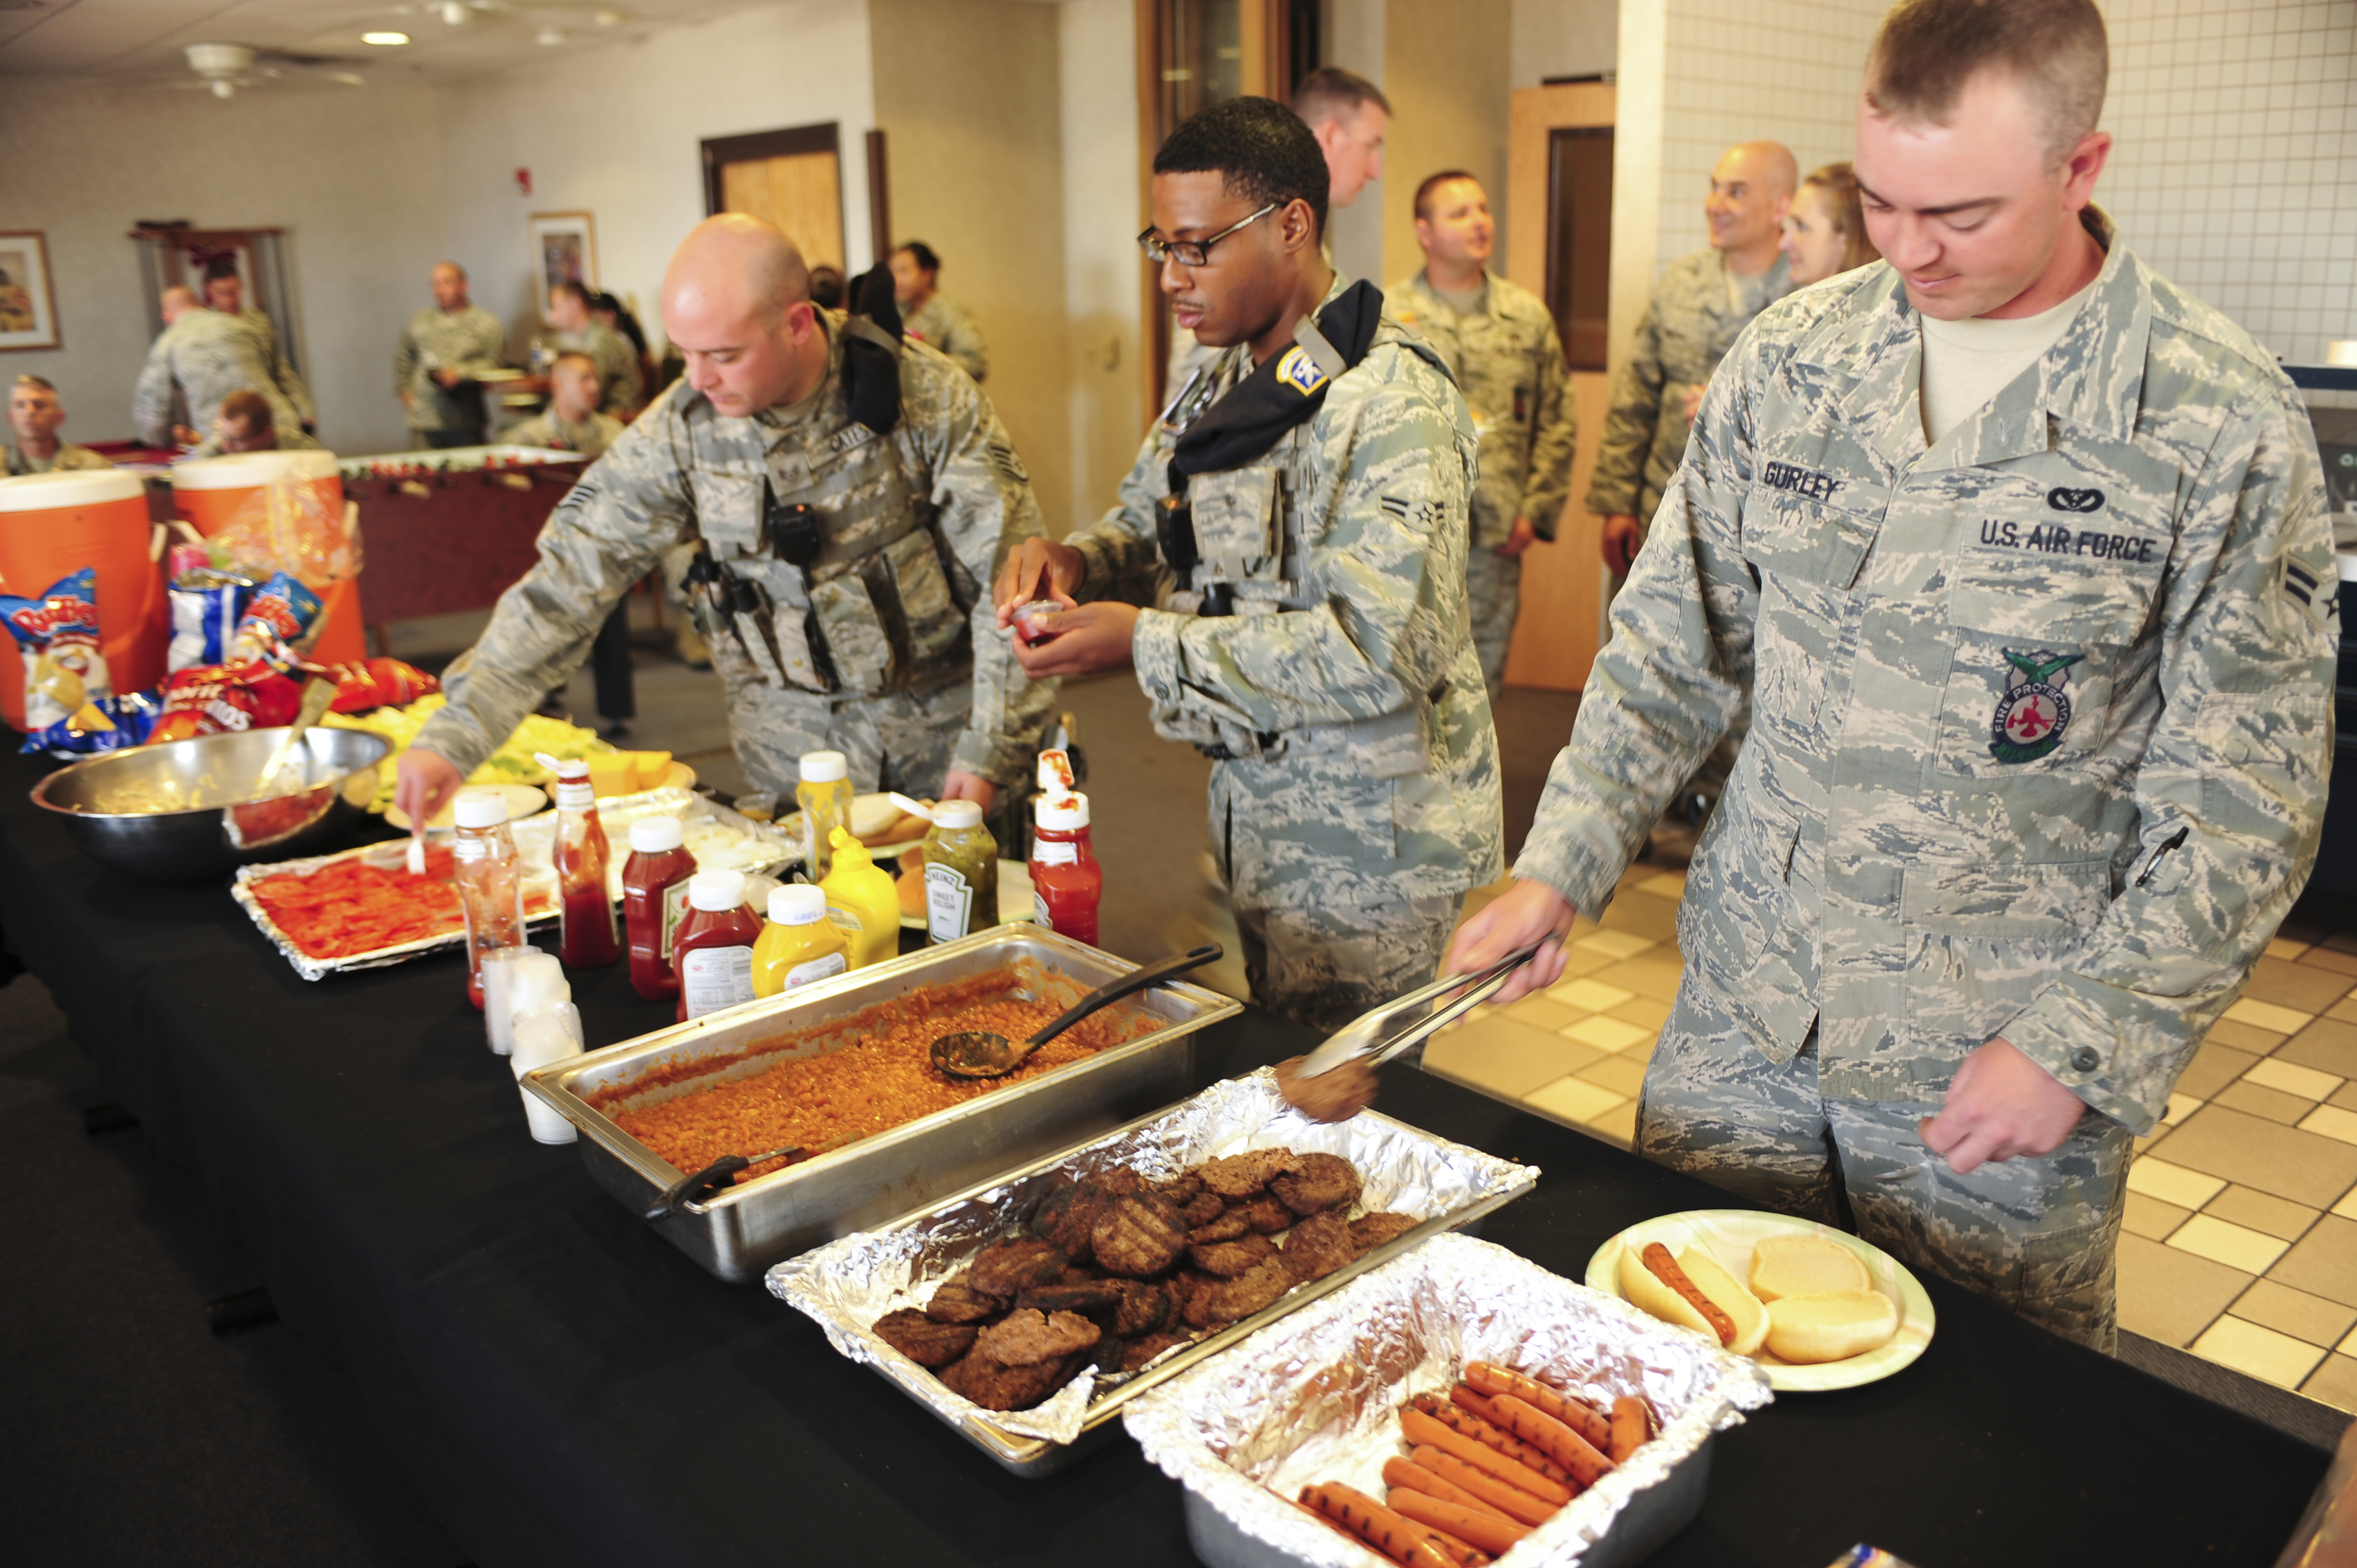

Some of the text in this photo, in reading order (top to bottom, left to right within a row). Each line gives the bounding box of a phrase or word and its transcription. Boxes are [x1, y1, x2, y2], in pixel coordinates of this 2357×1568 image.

[1764, 461, 1840, 501] GURLEY
[1980, 519, 2158, 563] U.S. AIR FORCE
[1995, 682, 2068, 733] FIRE PROTECTION
[931, 871, 956, 886] HEINZ
